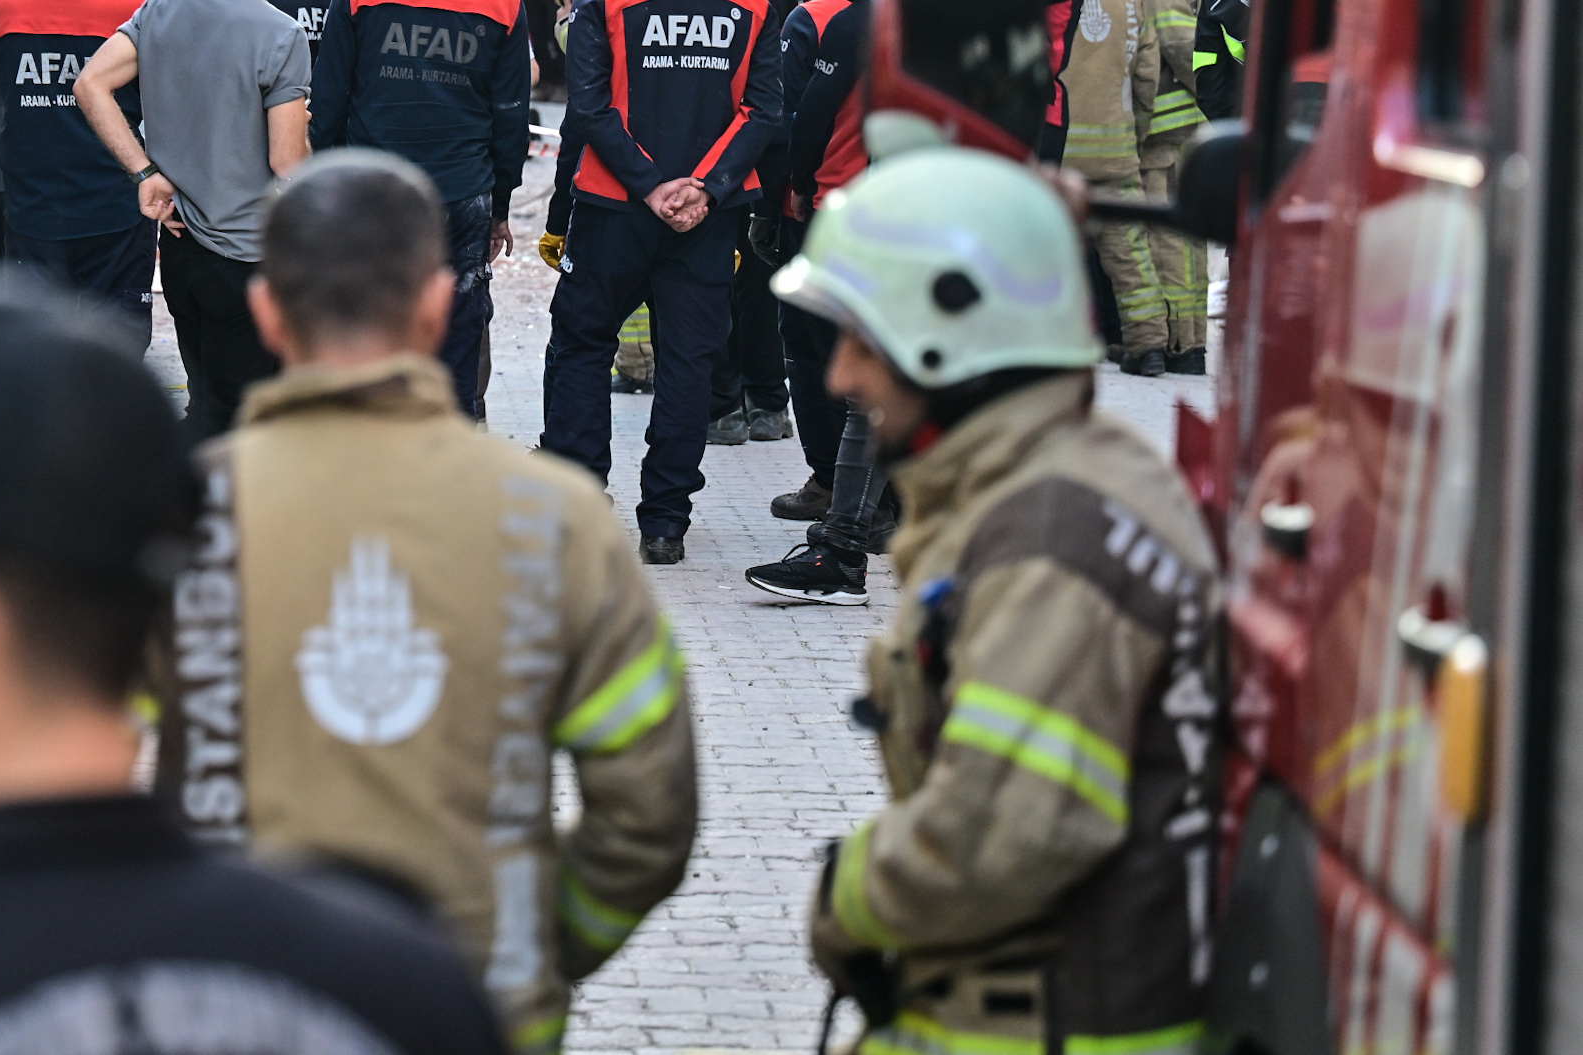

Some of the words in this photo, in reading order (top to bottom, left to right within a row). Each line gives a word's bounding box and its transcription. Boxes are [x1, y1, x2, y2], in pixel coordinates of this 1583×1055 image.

[380, 22, 478, 64] AFAD
[642, 14, 735, 48] AFAD
[15, 52, 93, 85] AFA
[379, 65, 414, 80] ARAMA
[422, 69, 472, 86] KURTARMA
[642, 55, 674, 69] ARAMA
[680, 55, 730, 71] KURTARMA
[20, 95, 51, 107] ARAMA
